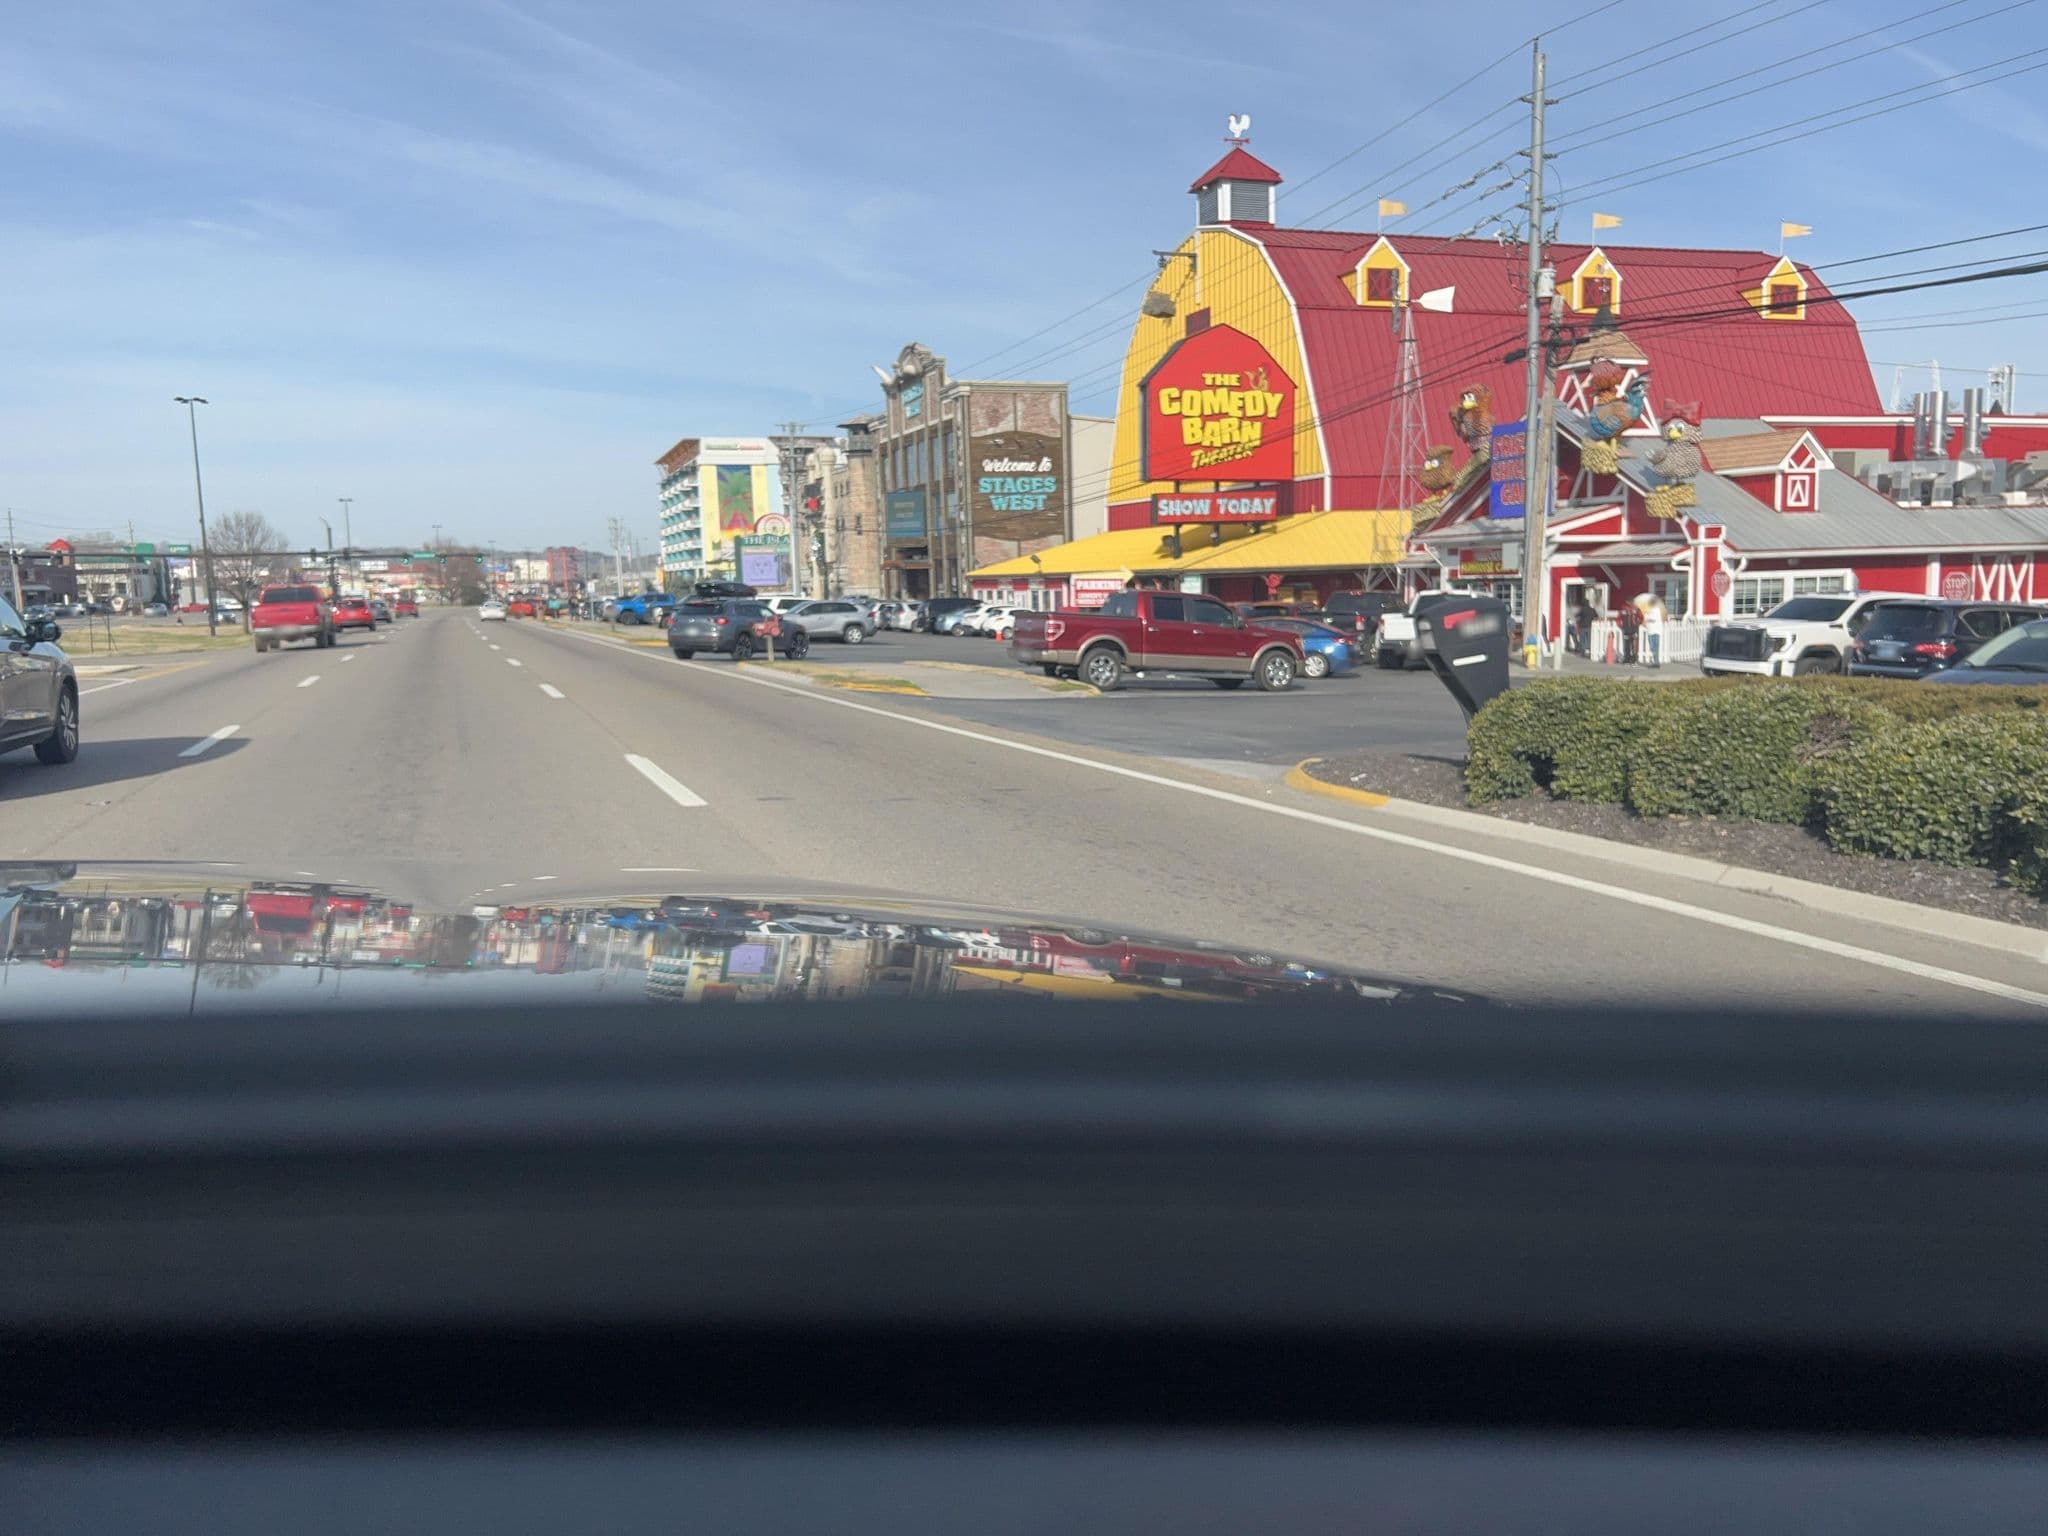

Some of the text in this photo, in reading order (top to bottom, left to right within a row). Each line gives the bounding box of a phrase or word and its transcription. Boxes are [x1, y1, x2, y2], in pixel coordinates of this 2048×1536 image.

[1202, 373, 1241, 386] THE
[1159, 387, 1284, 418] COMEDY
[1181, 417, 1262, 447] BARN
[982, 457, 1053, 472] Welcome to
[979, 477, 1056, 494] STAGES
[990, 494, 1048, 511] WEST
[1157, 498, 1275, 517] SHOW TODAY
[1945, 577, 1968, 590] STOP
